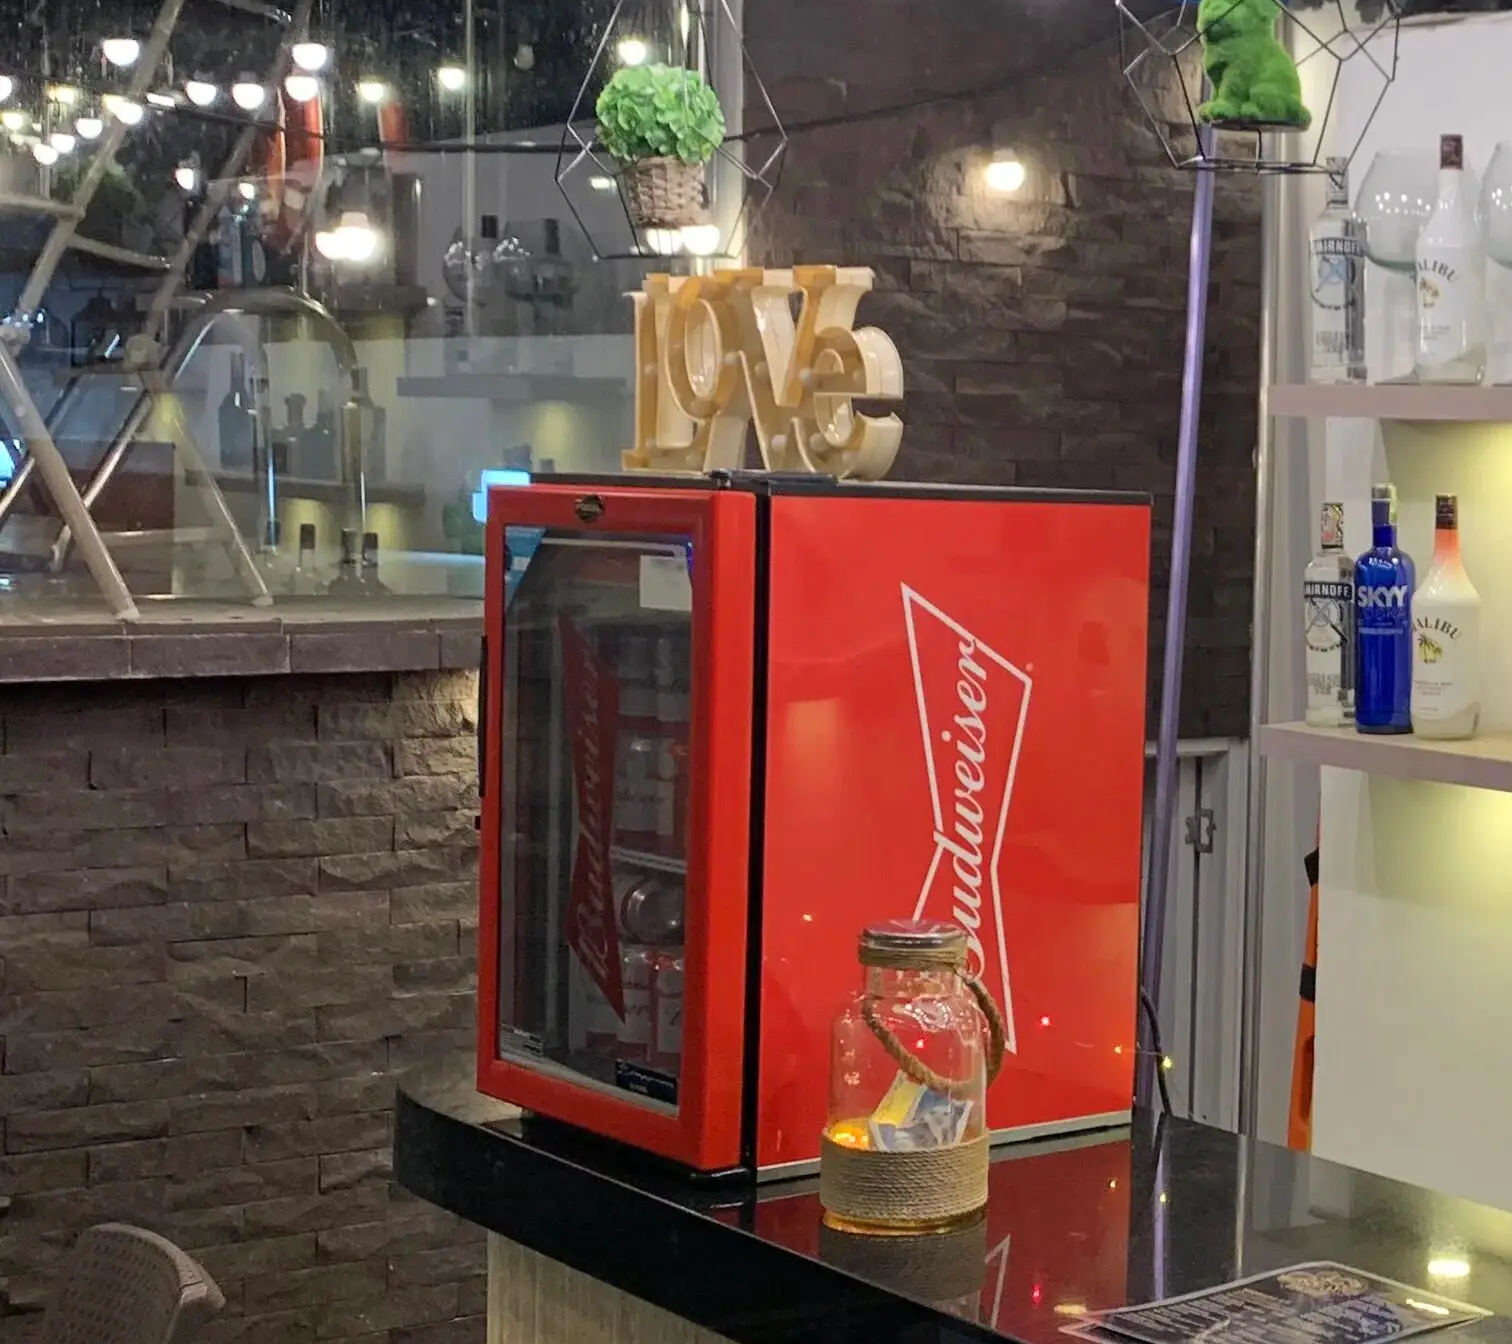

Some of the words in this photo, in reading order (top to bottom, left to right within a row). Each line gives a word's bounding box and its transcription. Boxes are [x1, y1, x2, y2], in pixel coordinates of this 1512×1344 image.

[1417, 258, 1460, 284] ALIBU
[1358, 585, 1407, 607] SKYY
[932, 634, 988, 984] udweiser
